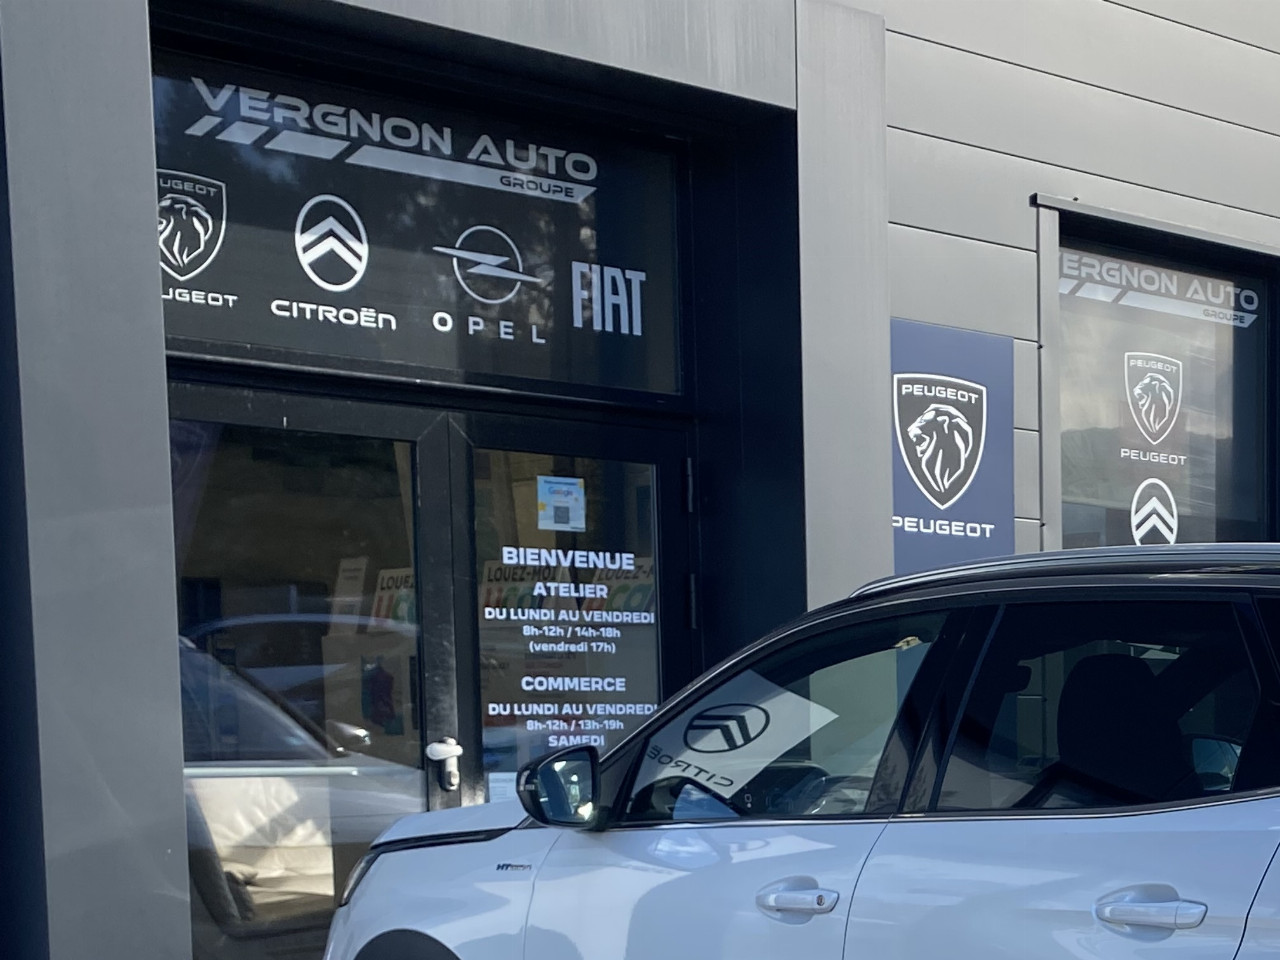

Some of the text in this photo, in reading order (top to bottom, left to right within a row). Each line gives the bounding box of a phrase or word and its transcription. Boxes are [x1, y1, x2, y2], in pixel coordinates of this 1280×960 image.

[191, 76, 598, 181] VERGNON AUTO
[159, 178, 218, 197] UGEOT
[499, 174, 575, 198] GROUPE
[1059, 252, 1259, 311] ERGNON AUTO
[161, 287, 239, 308] UGEOT
[571, 261, 646, 336] FIAT
[1202, 308, 1246, 324] GROUPE
[432, 311, 547, 345] OPEL
[1129, 359, 1178, 374] PEUGEOT
[902, 384, 979, 404] PEUGEOT
[1120, 448, 1188, 466] PEUGEOT
[891, 516, 995, 538] PEUGEOT
[502, 546, 635, 571] BIENVENUE
[533, 581, 609, 599] ATELIER
[484, 607, 655, 624] DU LUNDI AU VENDREDI
[522, 625, 621, 638] 8h-12h / 14h-18h
[529, 641, 616, 654] (vendredi 17h)
[521, 676, 626, 691] COMMERCE
[488, 703, 511, 715] DU
[513, 703, 558, 716] LUNDI
[561, 703, 583, 715] AU
[526, 720, 624, 731] 8h-12h / 13h-19h
[548, 735, 605, 747] SAMEDI
